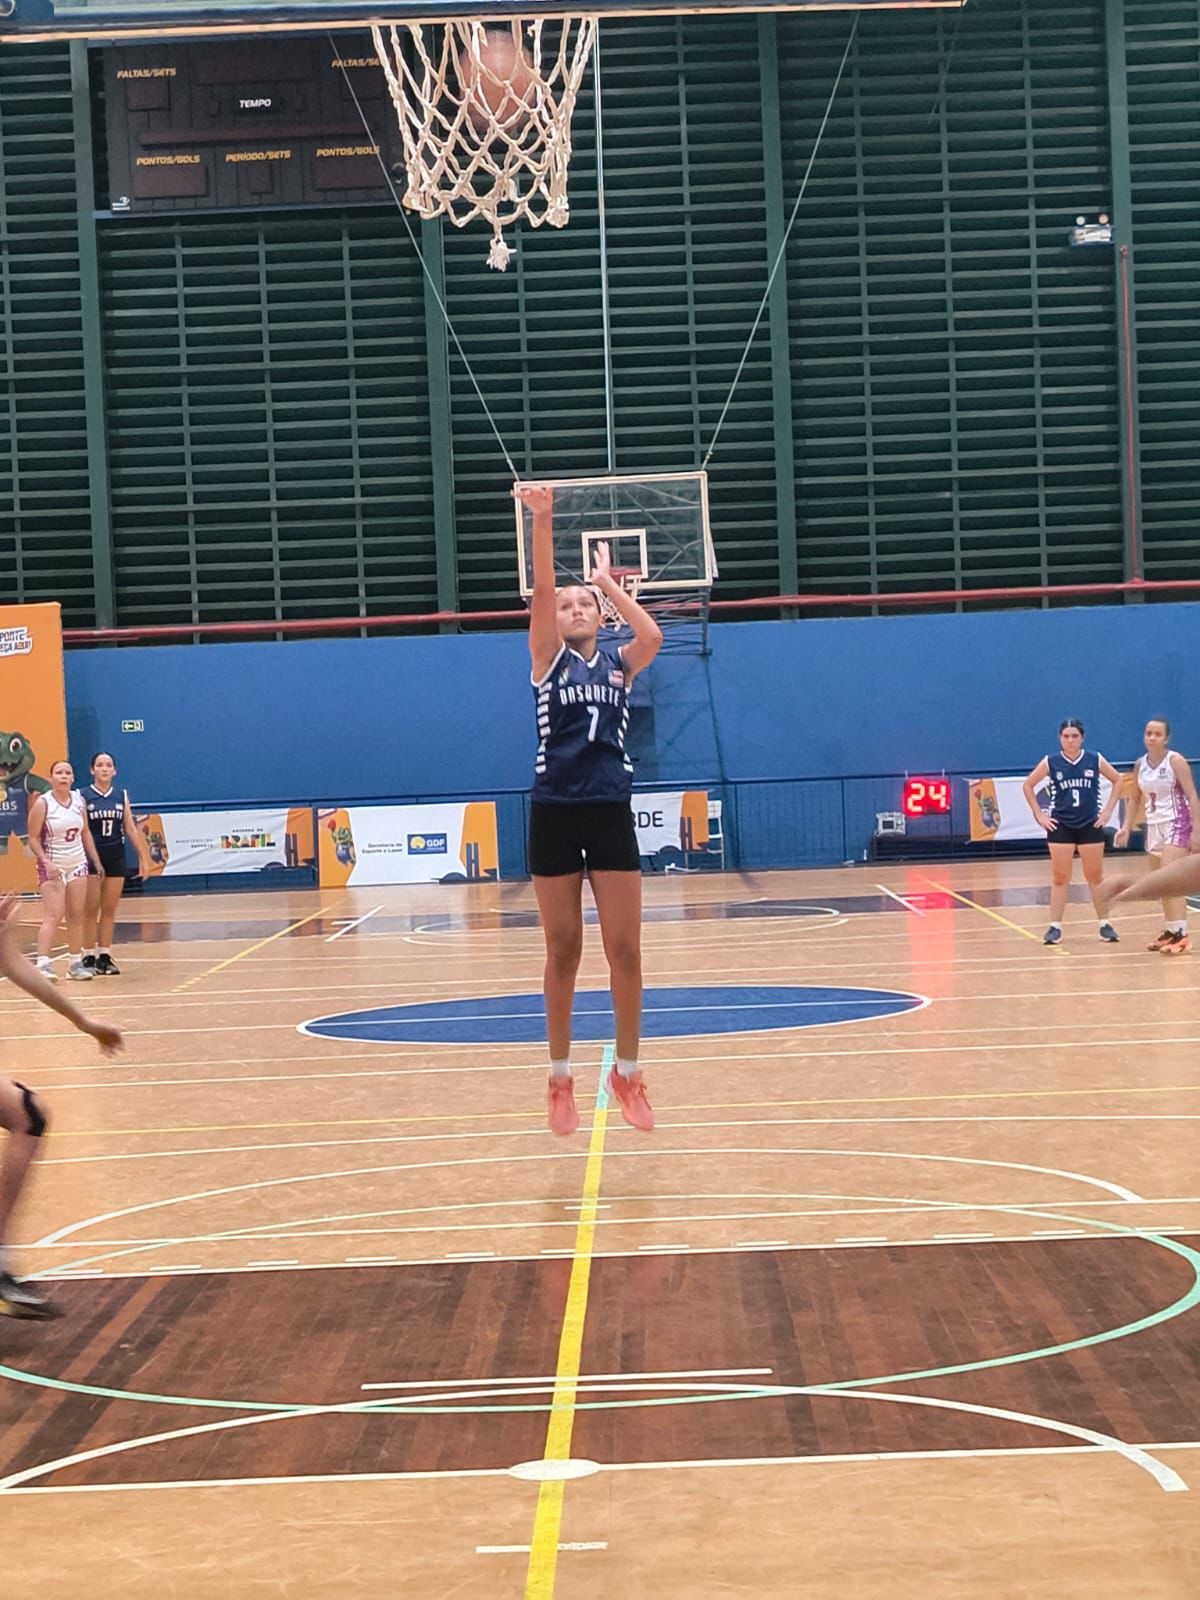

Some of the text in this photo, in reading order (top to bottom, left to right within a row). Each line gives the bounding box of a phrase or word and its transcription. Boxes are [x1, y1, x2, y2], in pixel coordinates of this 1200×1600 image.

[117, 67, 176, 79] FALTAS/SETS
[240, 99, 272, 109] TEMPO
[316, 146, 380, 157] PONTOS/GOLS
[136, 155, 200, 166] PONTOS/GOLS
[560, 684, 620, 707] BASQUETE
[586, 705, 599, 742] 7
[907, 783, 946, 812] 24
[1071, 789, 1080, 807] 9
[102, 820, 113, 836] 13
[221, 832, 276, 848] BRASIL
